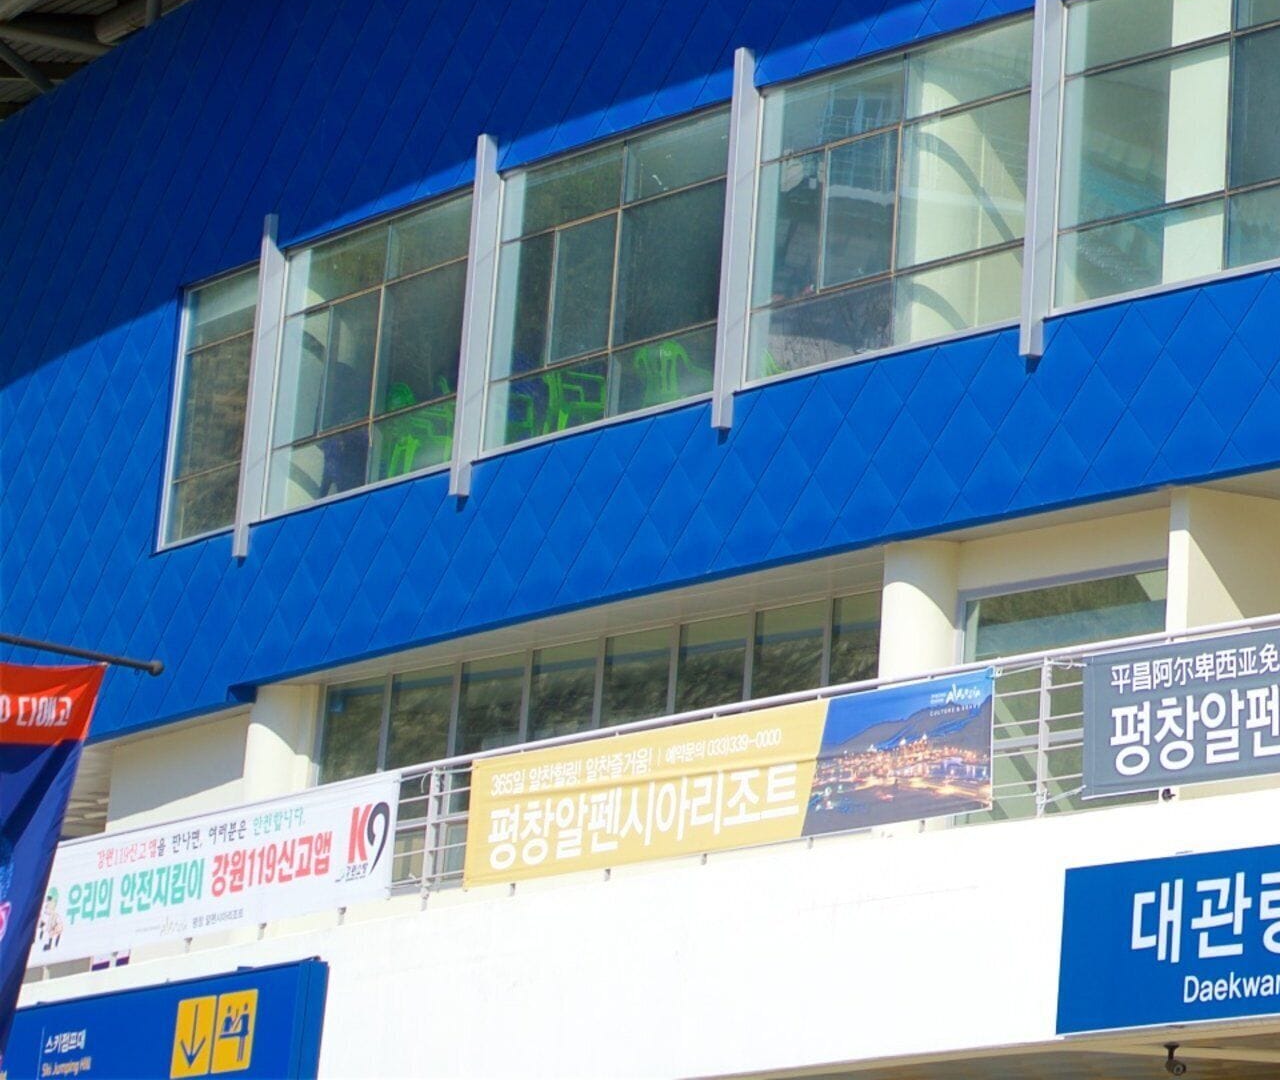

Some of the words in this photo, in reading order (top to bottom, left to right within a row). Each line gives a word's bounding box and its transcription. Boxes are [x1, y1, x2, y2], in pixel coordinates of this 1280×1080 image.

[665, 739, 706, 765] 예약문의
[490, 769, 525, 797] 365일
[488, 761, 800, 871] 평창알펜시아리조트
[97, 837, 166, 869] 강원119신고앱을
[347, 801, 391, 875] K9
[66, 878, 114, 925] 우리의
[119, 858, 206, 915] 안전지킴이
[210, 831, 333, 898] 강원119신고앱
[44, 1028, 87, 1054] 스키점프대
